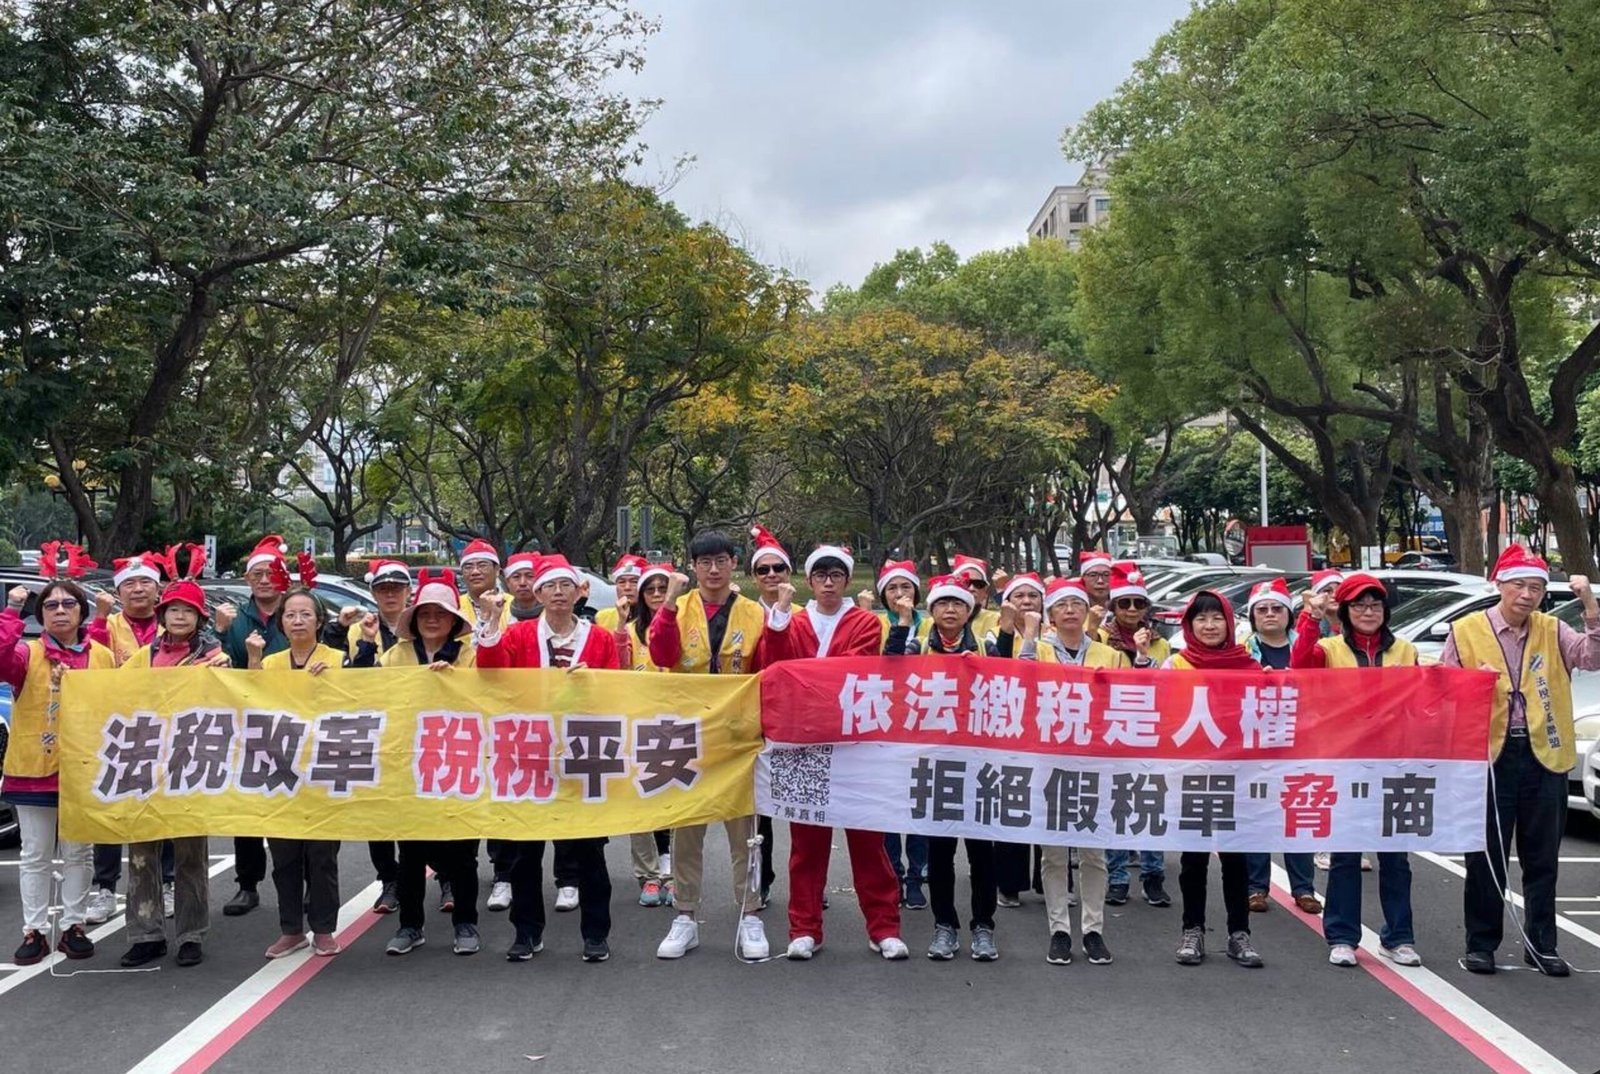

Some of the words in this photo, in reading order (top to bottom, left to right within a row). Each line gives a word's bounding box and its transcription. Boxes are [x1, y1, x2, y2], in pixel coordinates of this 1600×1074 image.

[839, 671, 1299, 749] 依法繳稅是人權
[97, 712, 382, 796] 法稅改革
[418, 715, 698, 798] 稅稅平安
[773, 804, 826, 823] 了解真相
